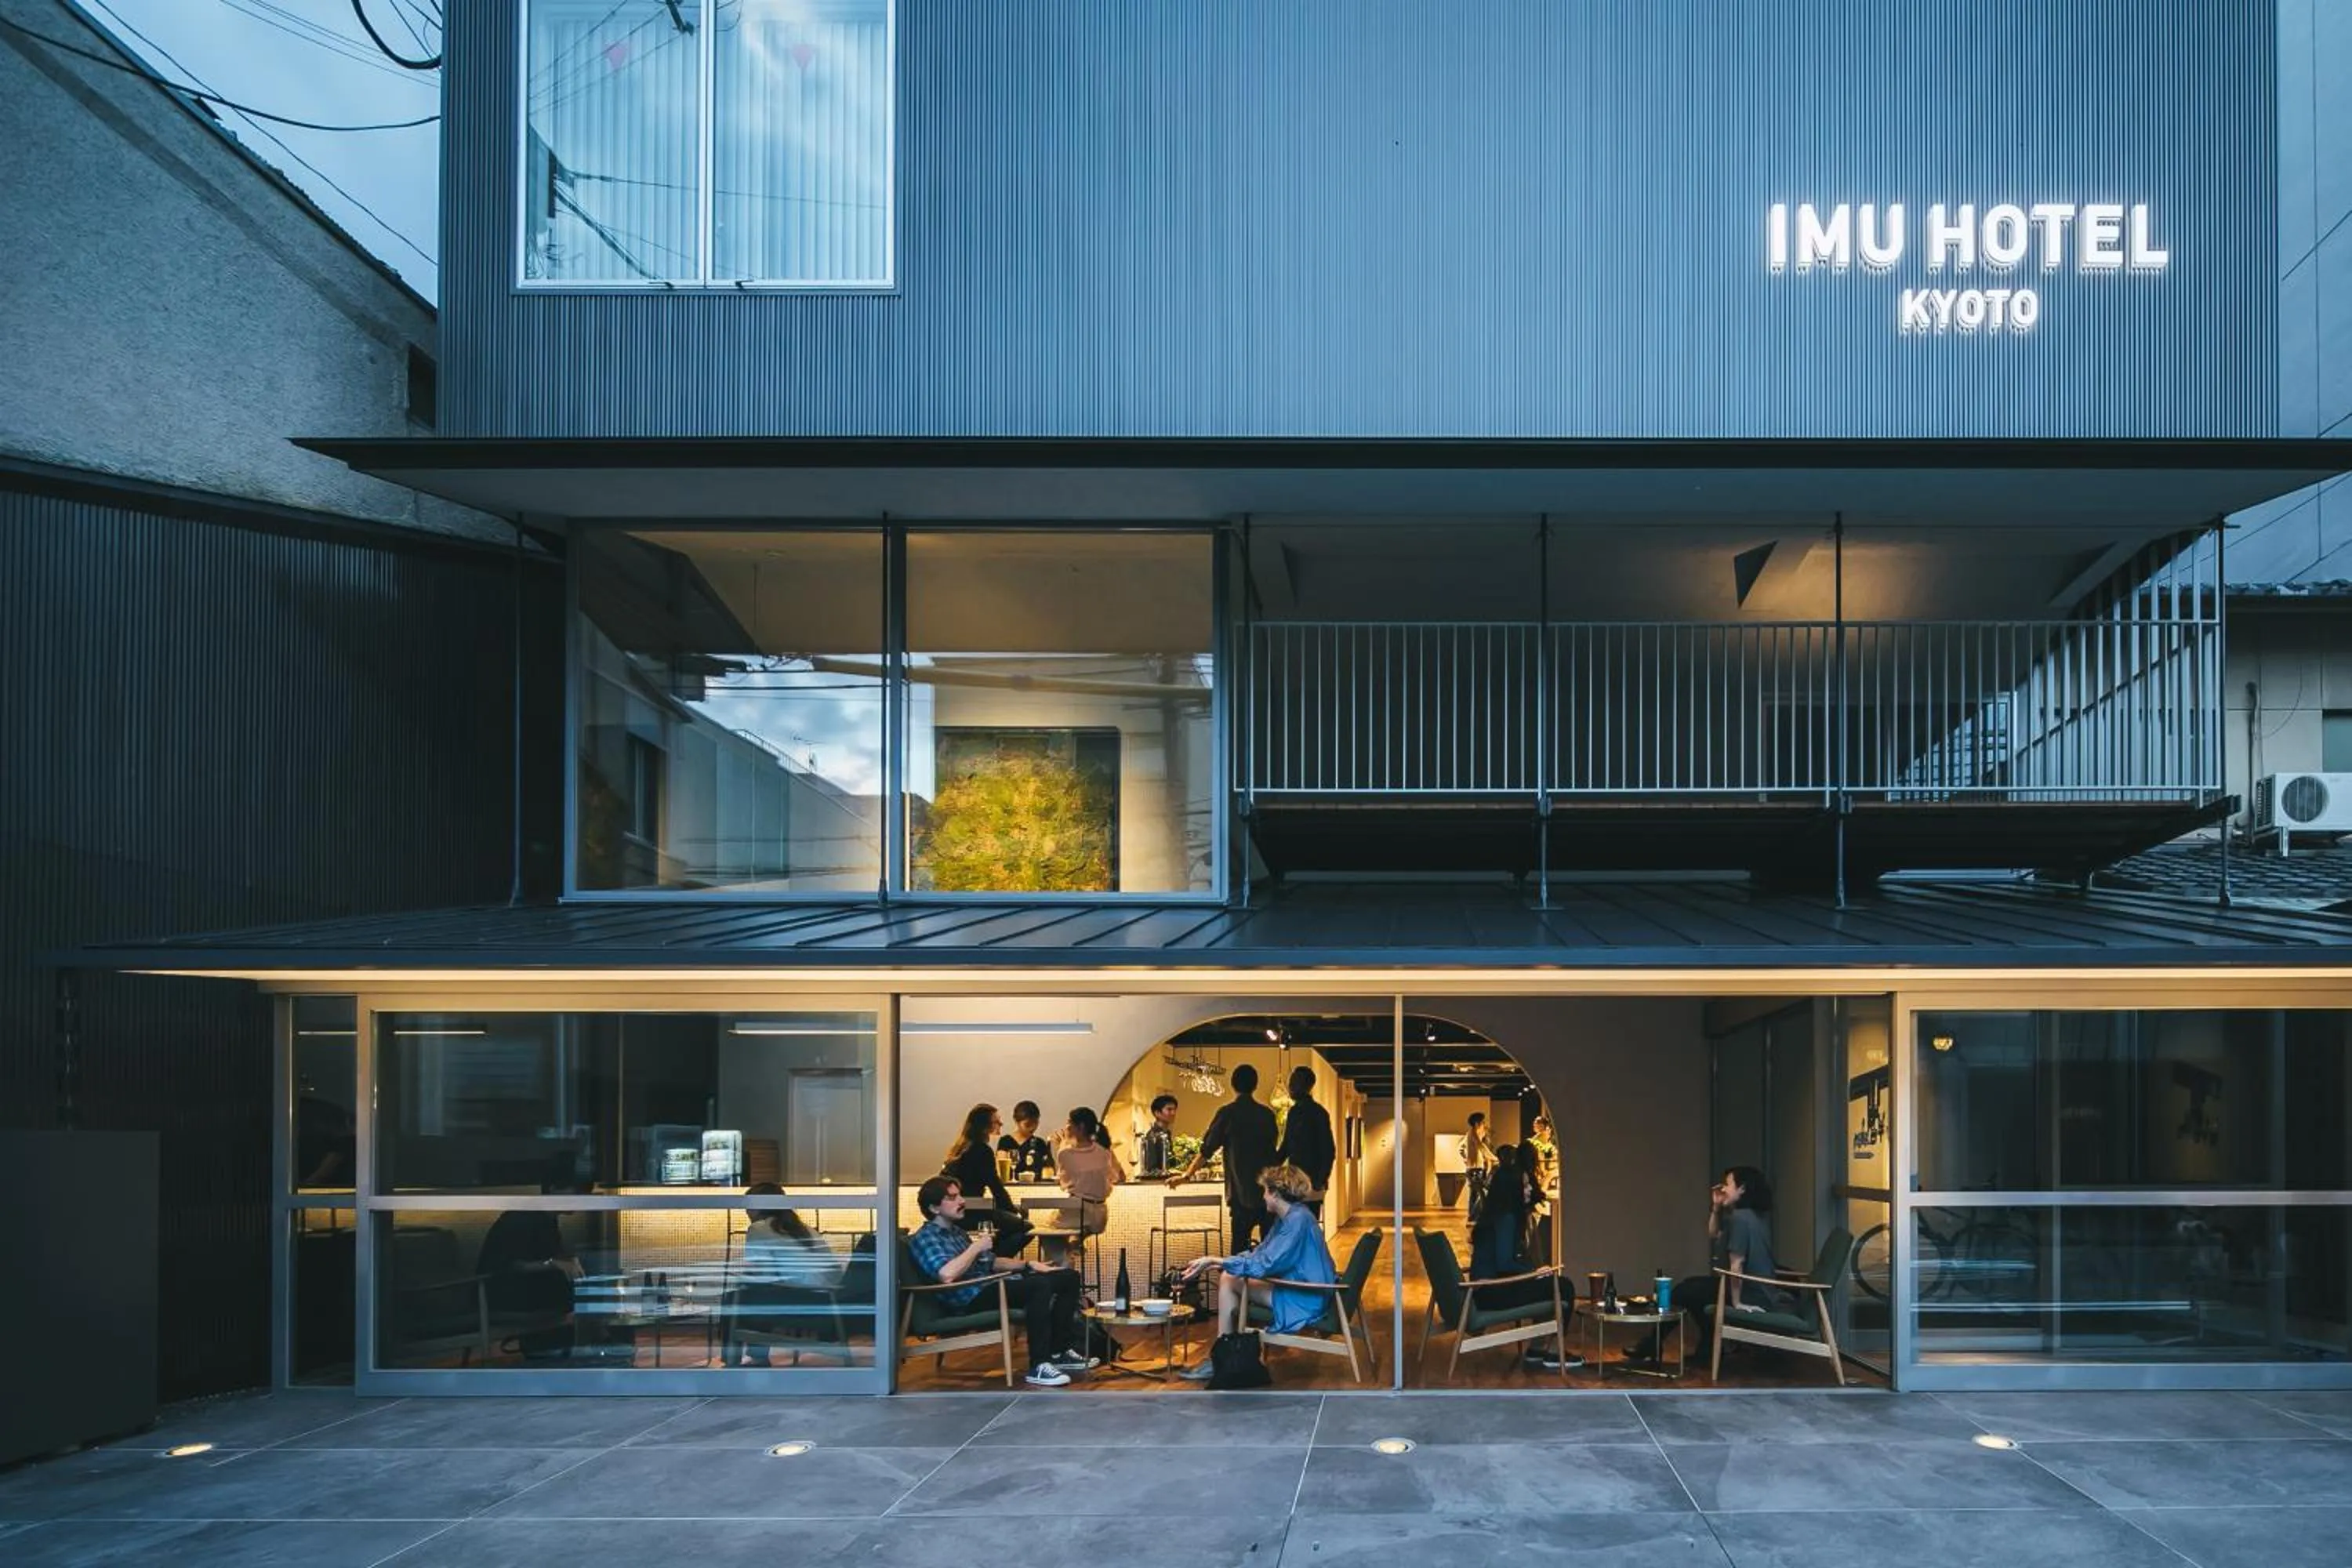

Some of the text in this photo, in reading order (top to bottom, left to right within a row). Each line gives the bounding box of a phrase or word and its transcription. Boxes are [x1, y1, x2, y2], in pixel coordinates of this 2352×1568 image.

[1769, 203, 2169, 270] IMU HOTEL
[1901, 289, 2038, 331] KYOTO
